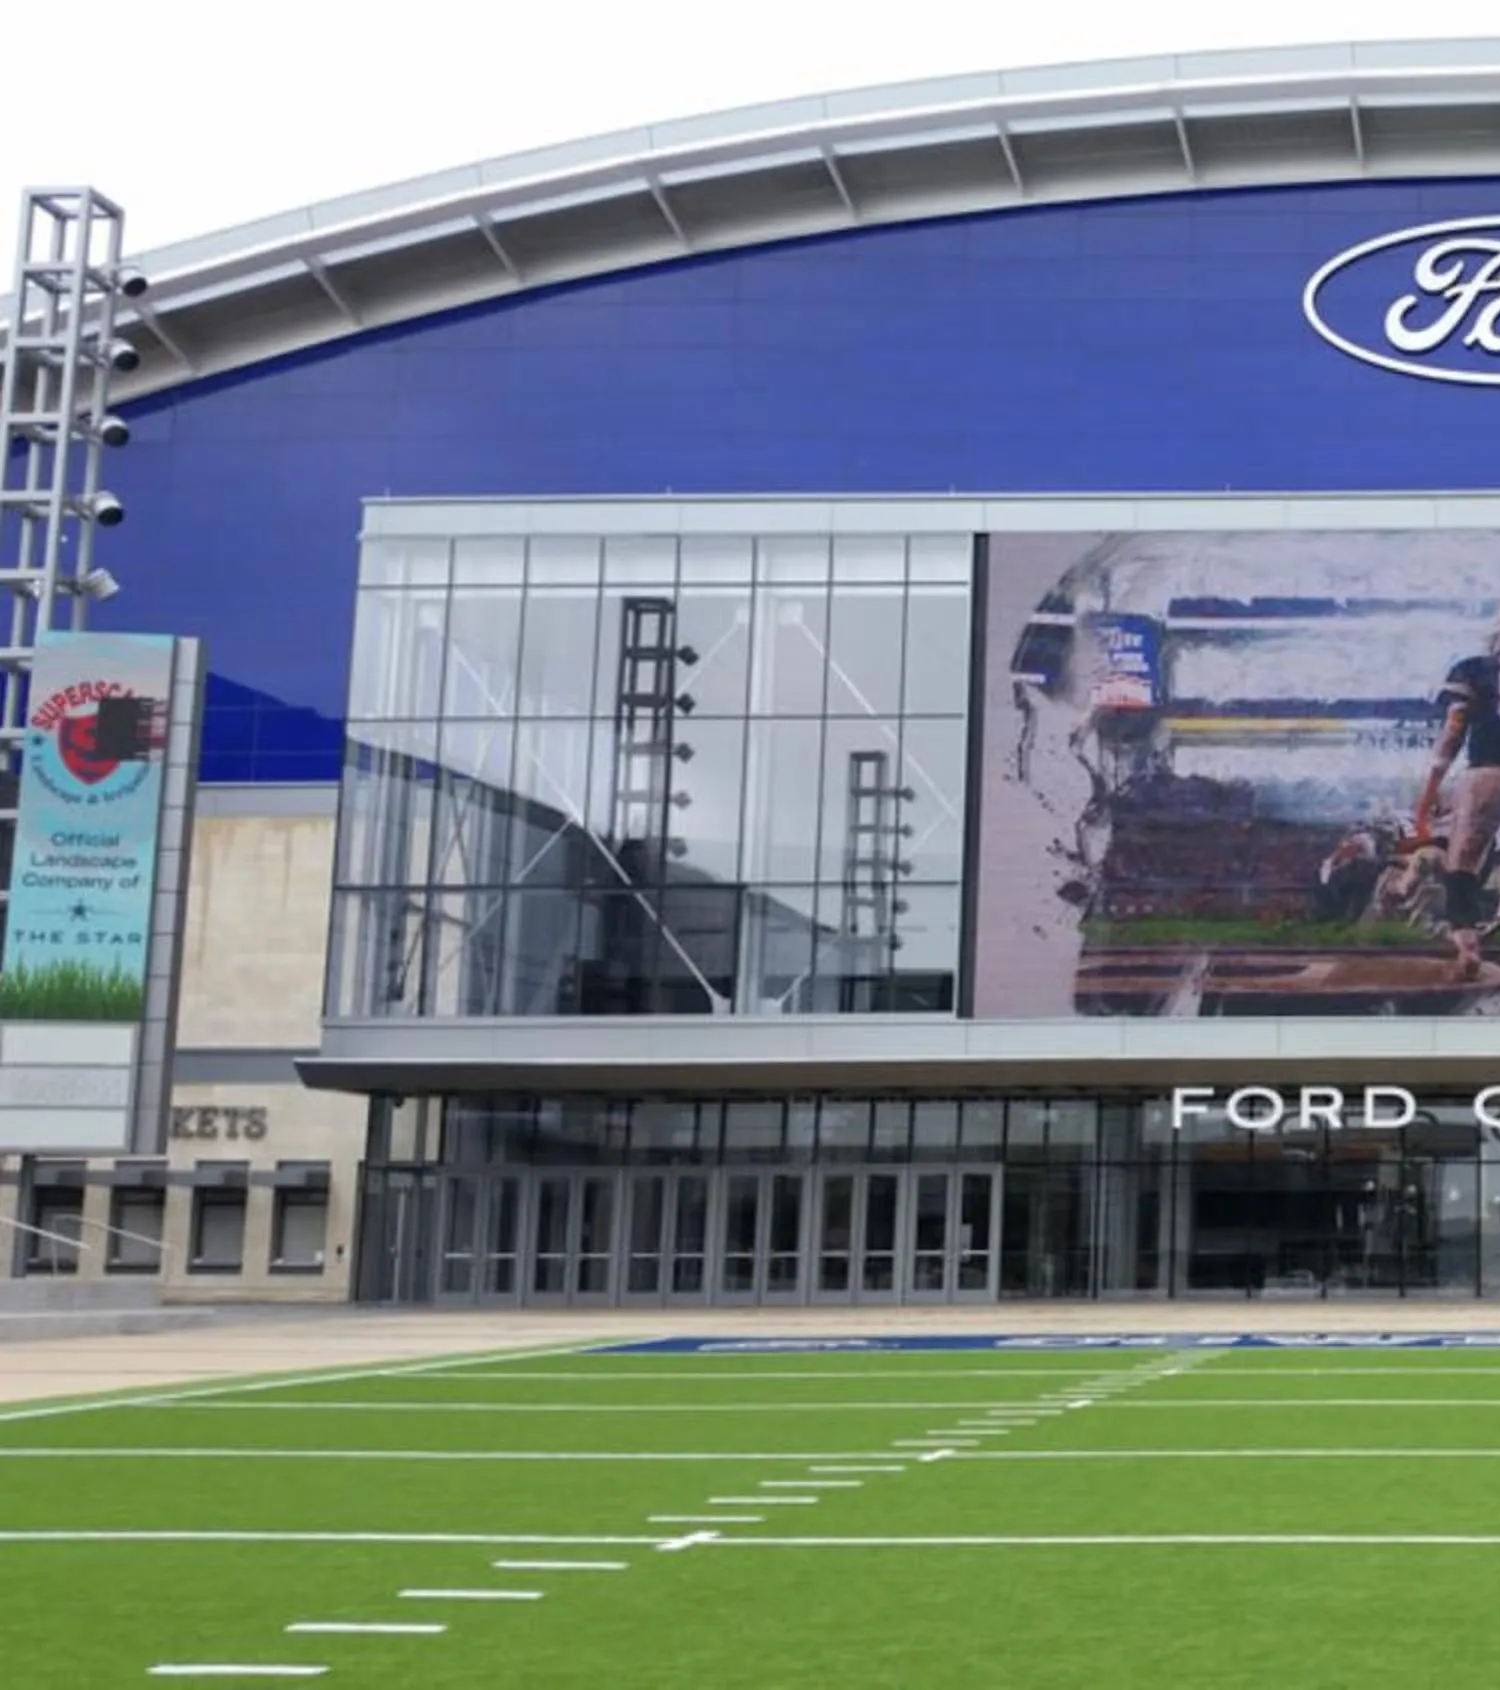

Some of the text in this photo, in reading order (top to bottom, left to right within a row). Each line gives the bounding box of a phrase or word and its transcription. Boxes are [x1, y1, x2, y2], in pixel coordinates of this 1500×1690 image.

[51, 832, 120, 847] Official
[30, 854, 138, 869] Landscape
[22, 871, 140, 891] Company of
[13, 929, 142, 944] THE STAR
[1171, 1085, 1418, 1129] FORD
